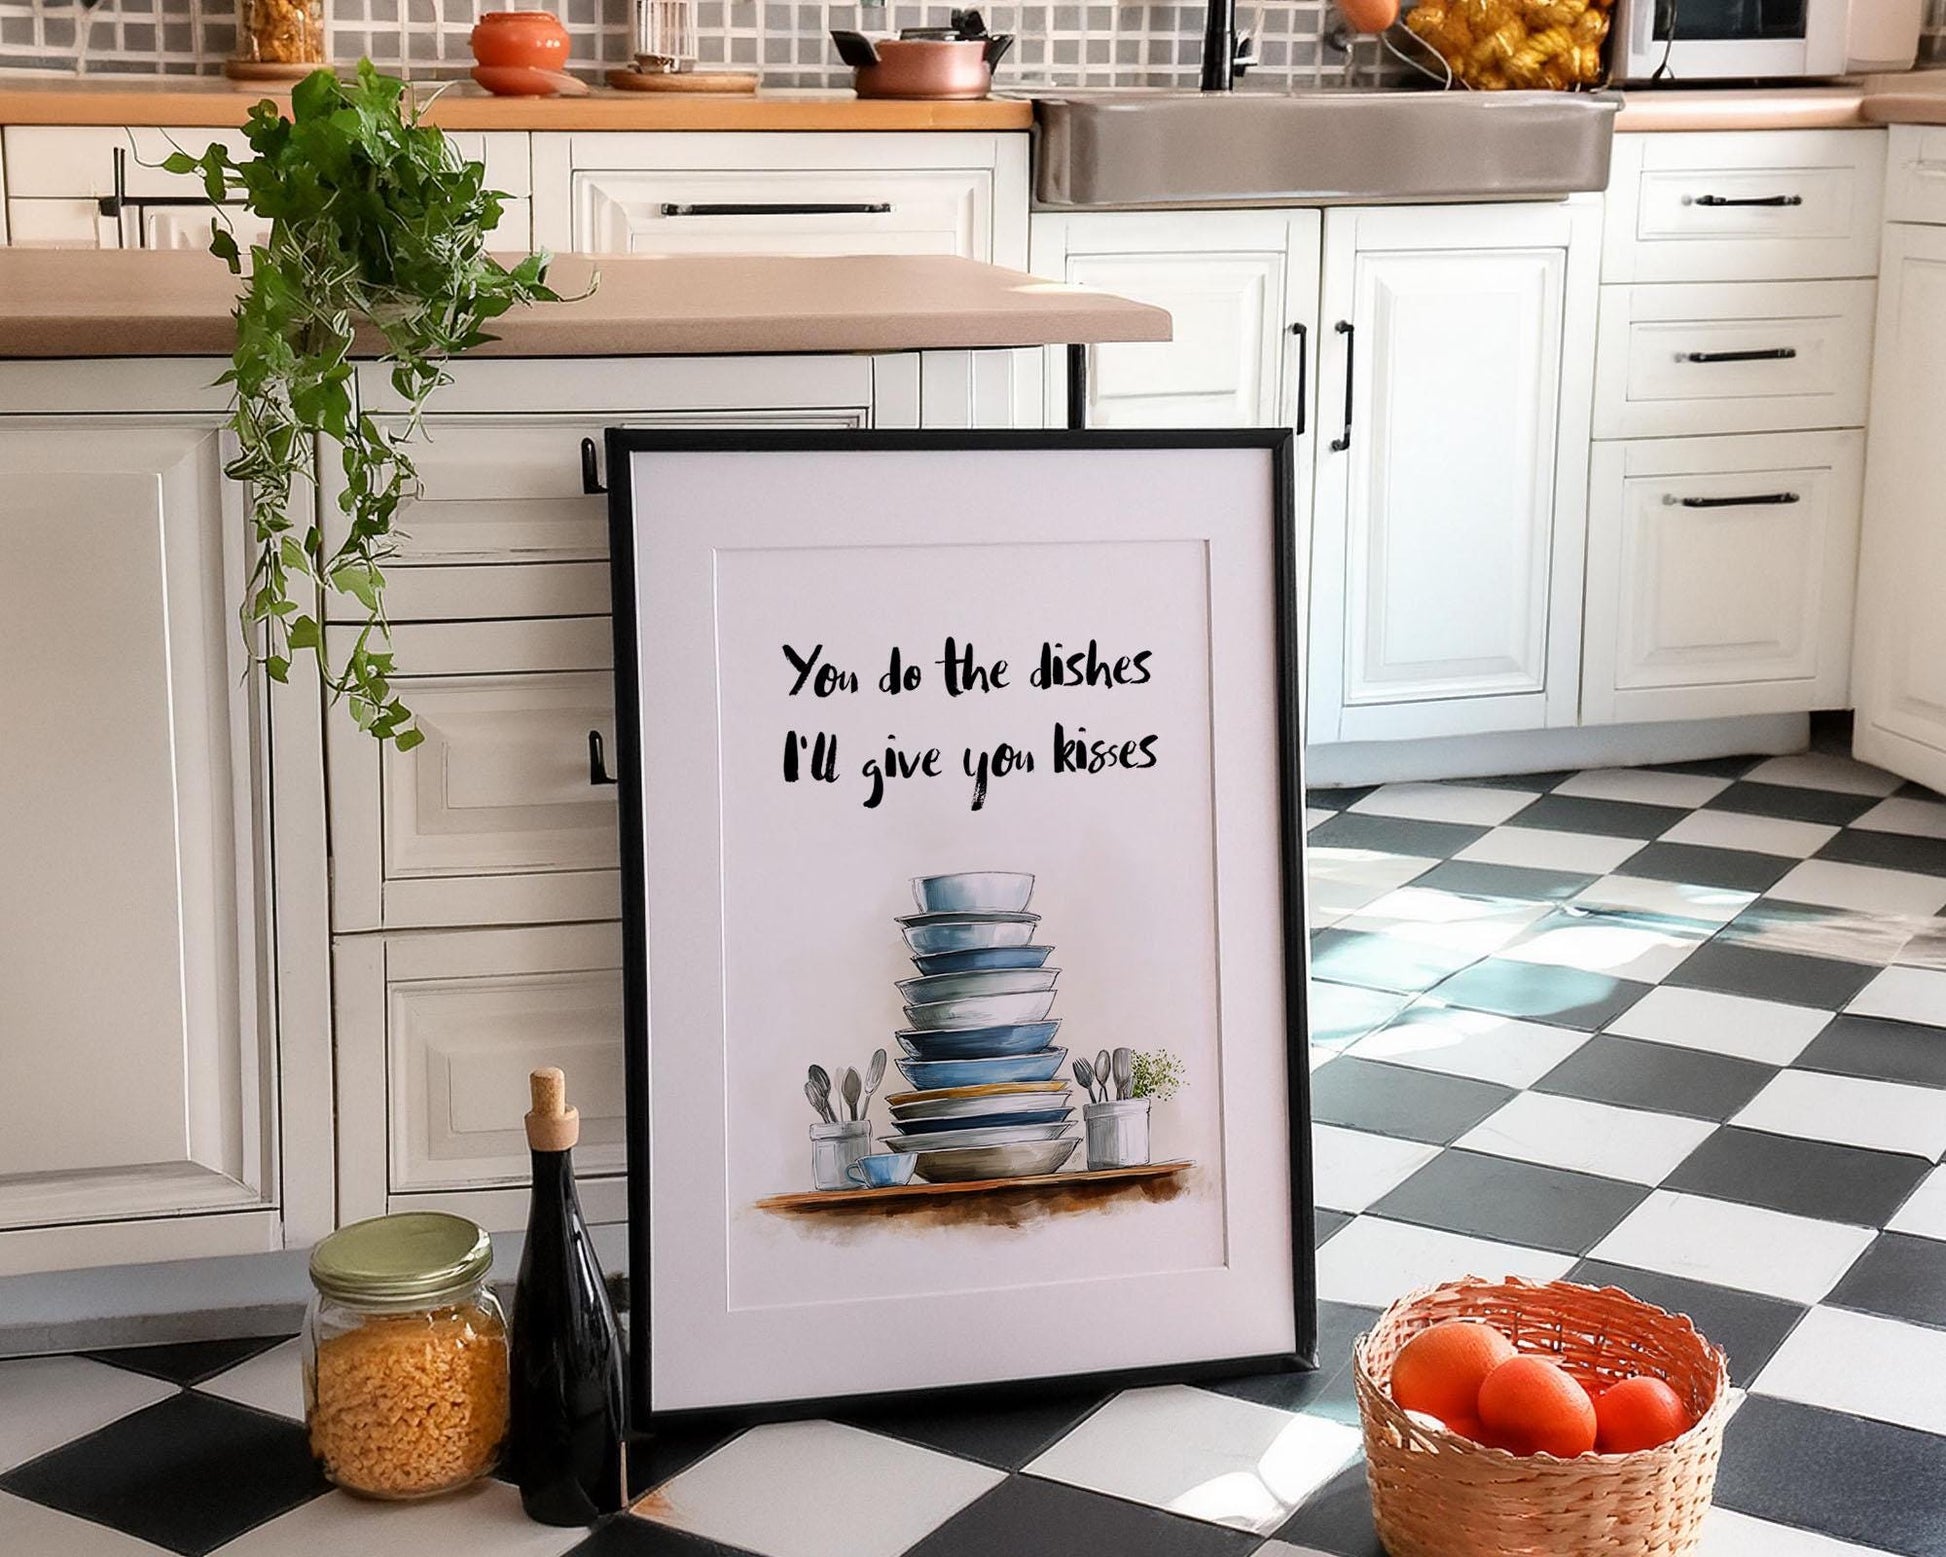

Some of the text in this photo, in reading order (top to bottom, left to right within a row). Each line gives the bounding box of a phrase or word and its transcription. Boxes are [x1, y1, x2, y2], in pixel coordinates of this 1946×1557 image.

[782, 636, 1153, 698] You do the dishes
[783, 722, 1159, 812] I'll give you kisses
